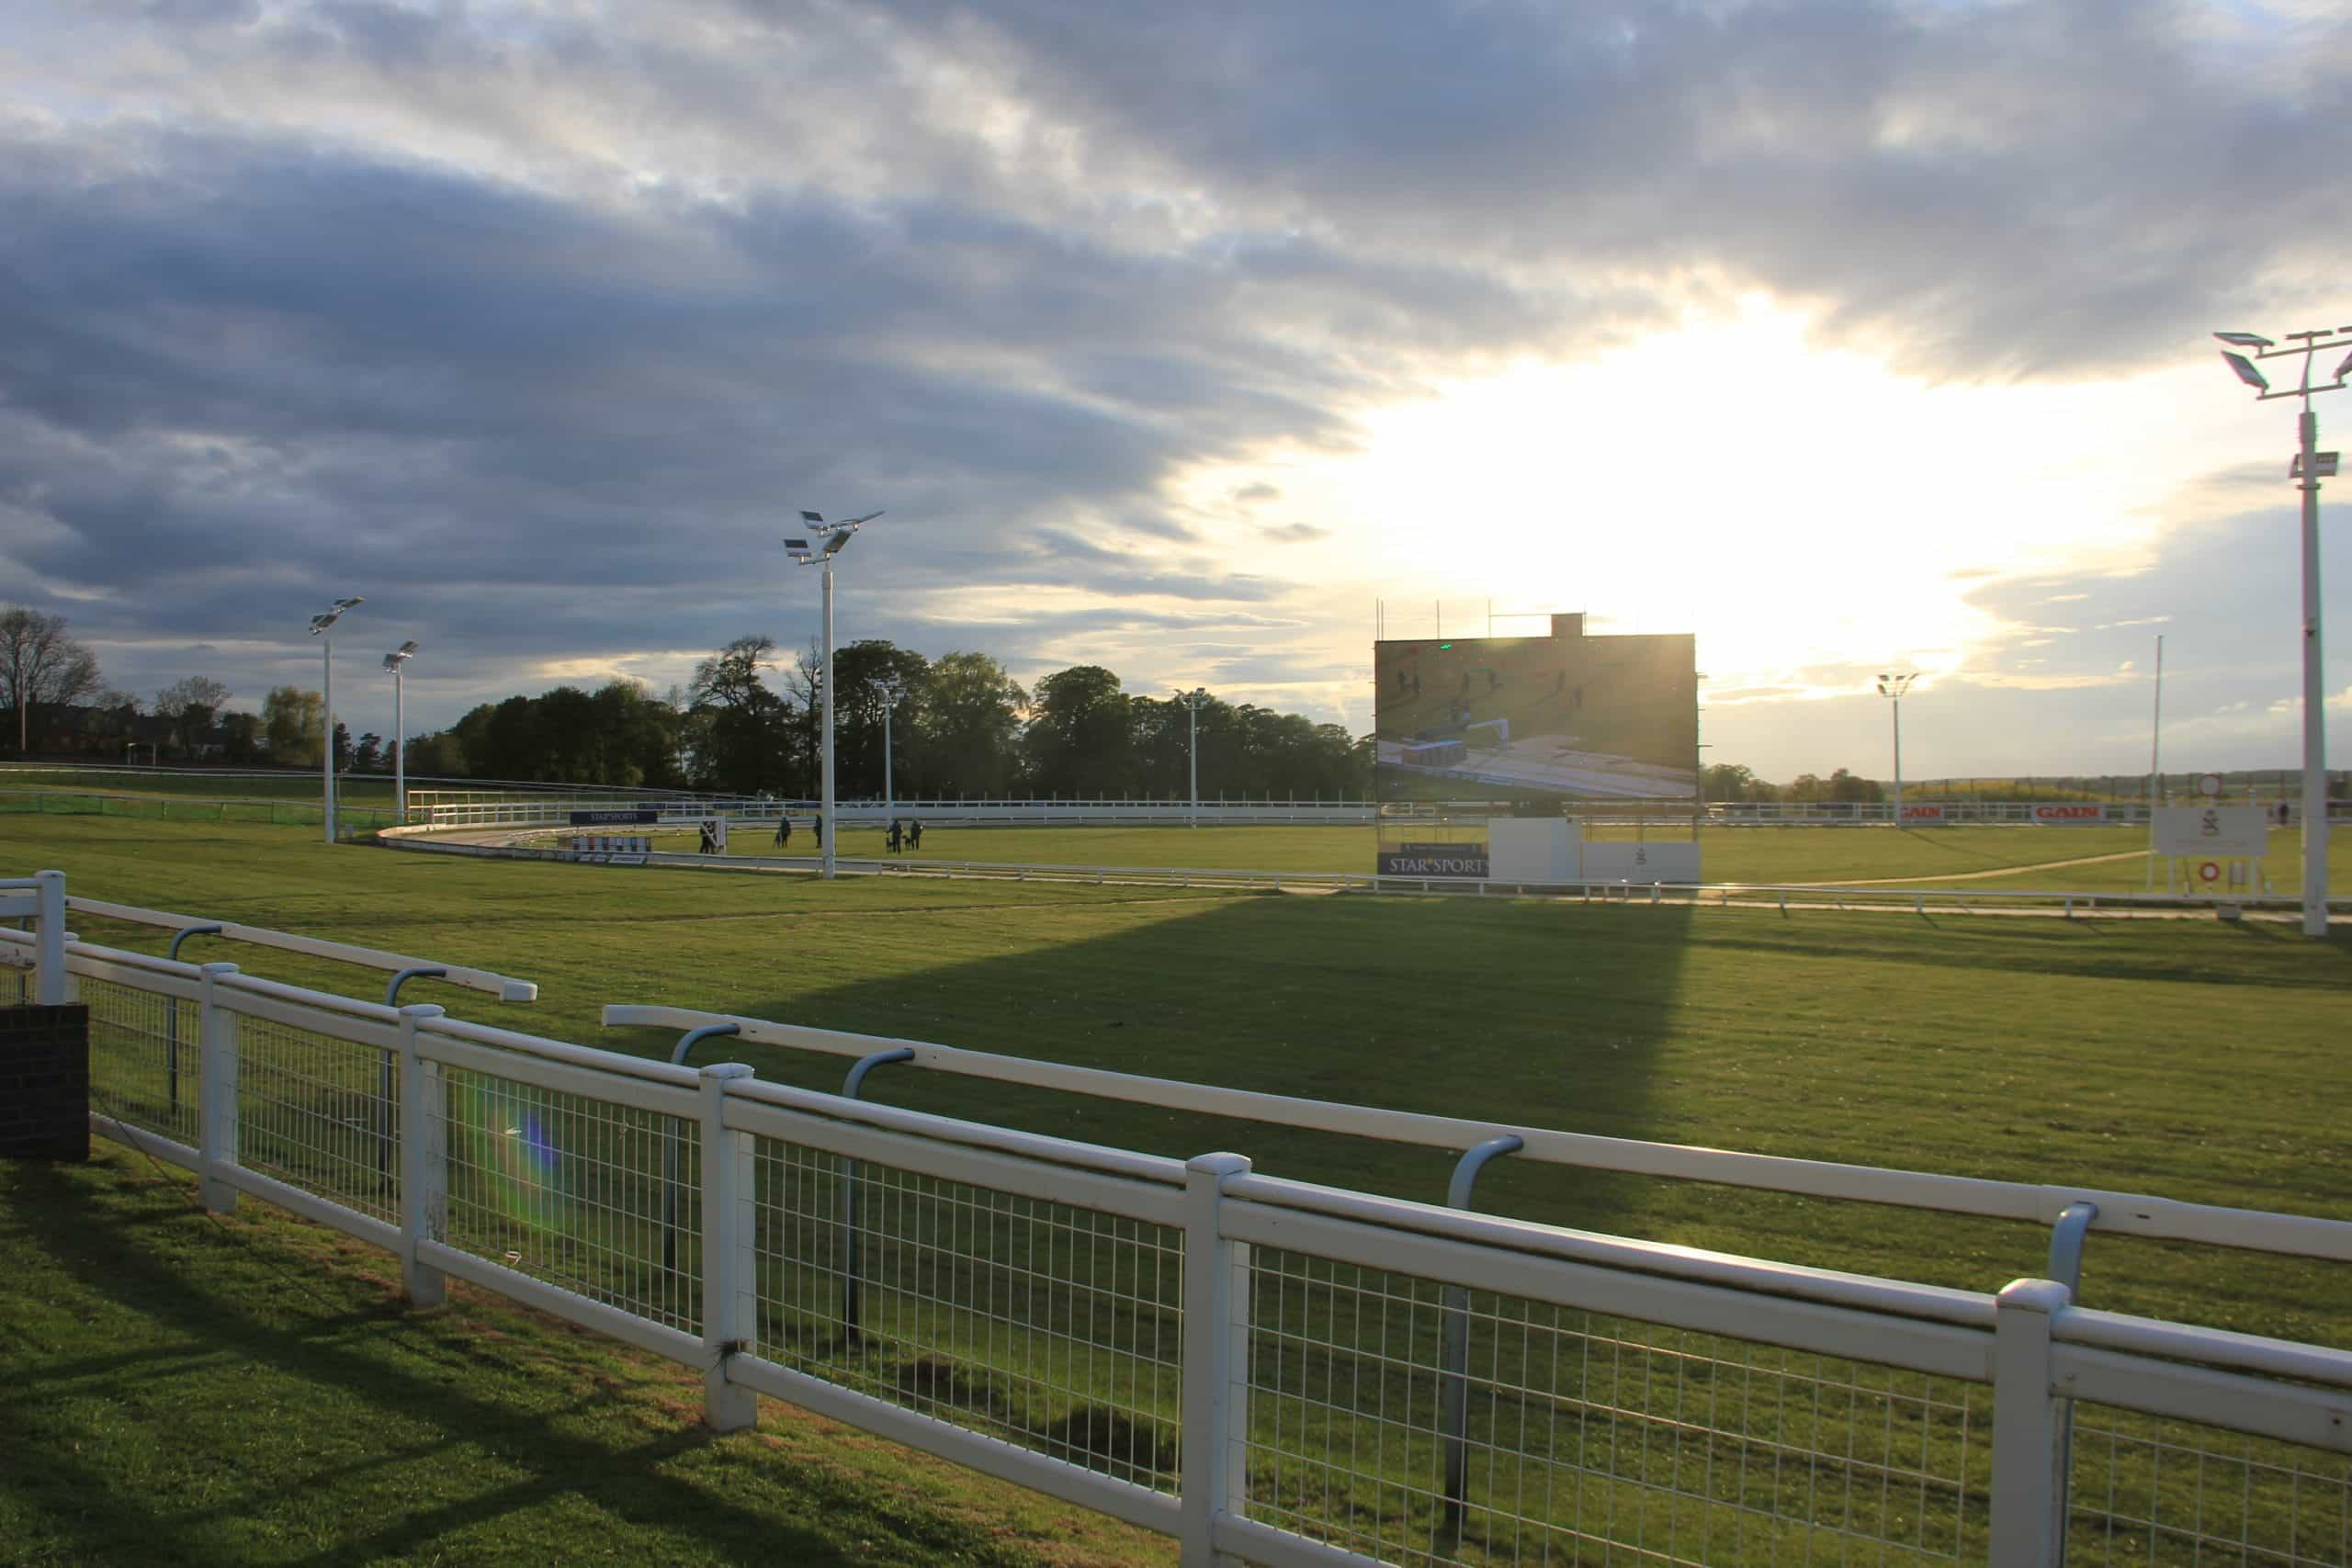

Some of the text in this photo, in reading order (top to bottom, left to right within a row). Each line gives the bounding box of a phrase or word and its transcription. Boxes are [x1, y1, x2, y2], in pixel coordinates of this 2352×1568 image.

[610, 812, 639, 821] SPORTS
[2036, 807, 2099, 818] GAIN
[1390, 858, 1429, 872] STAR
